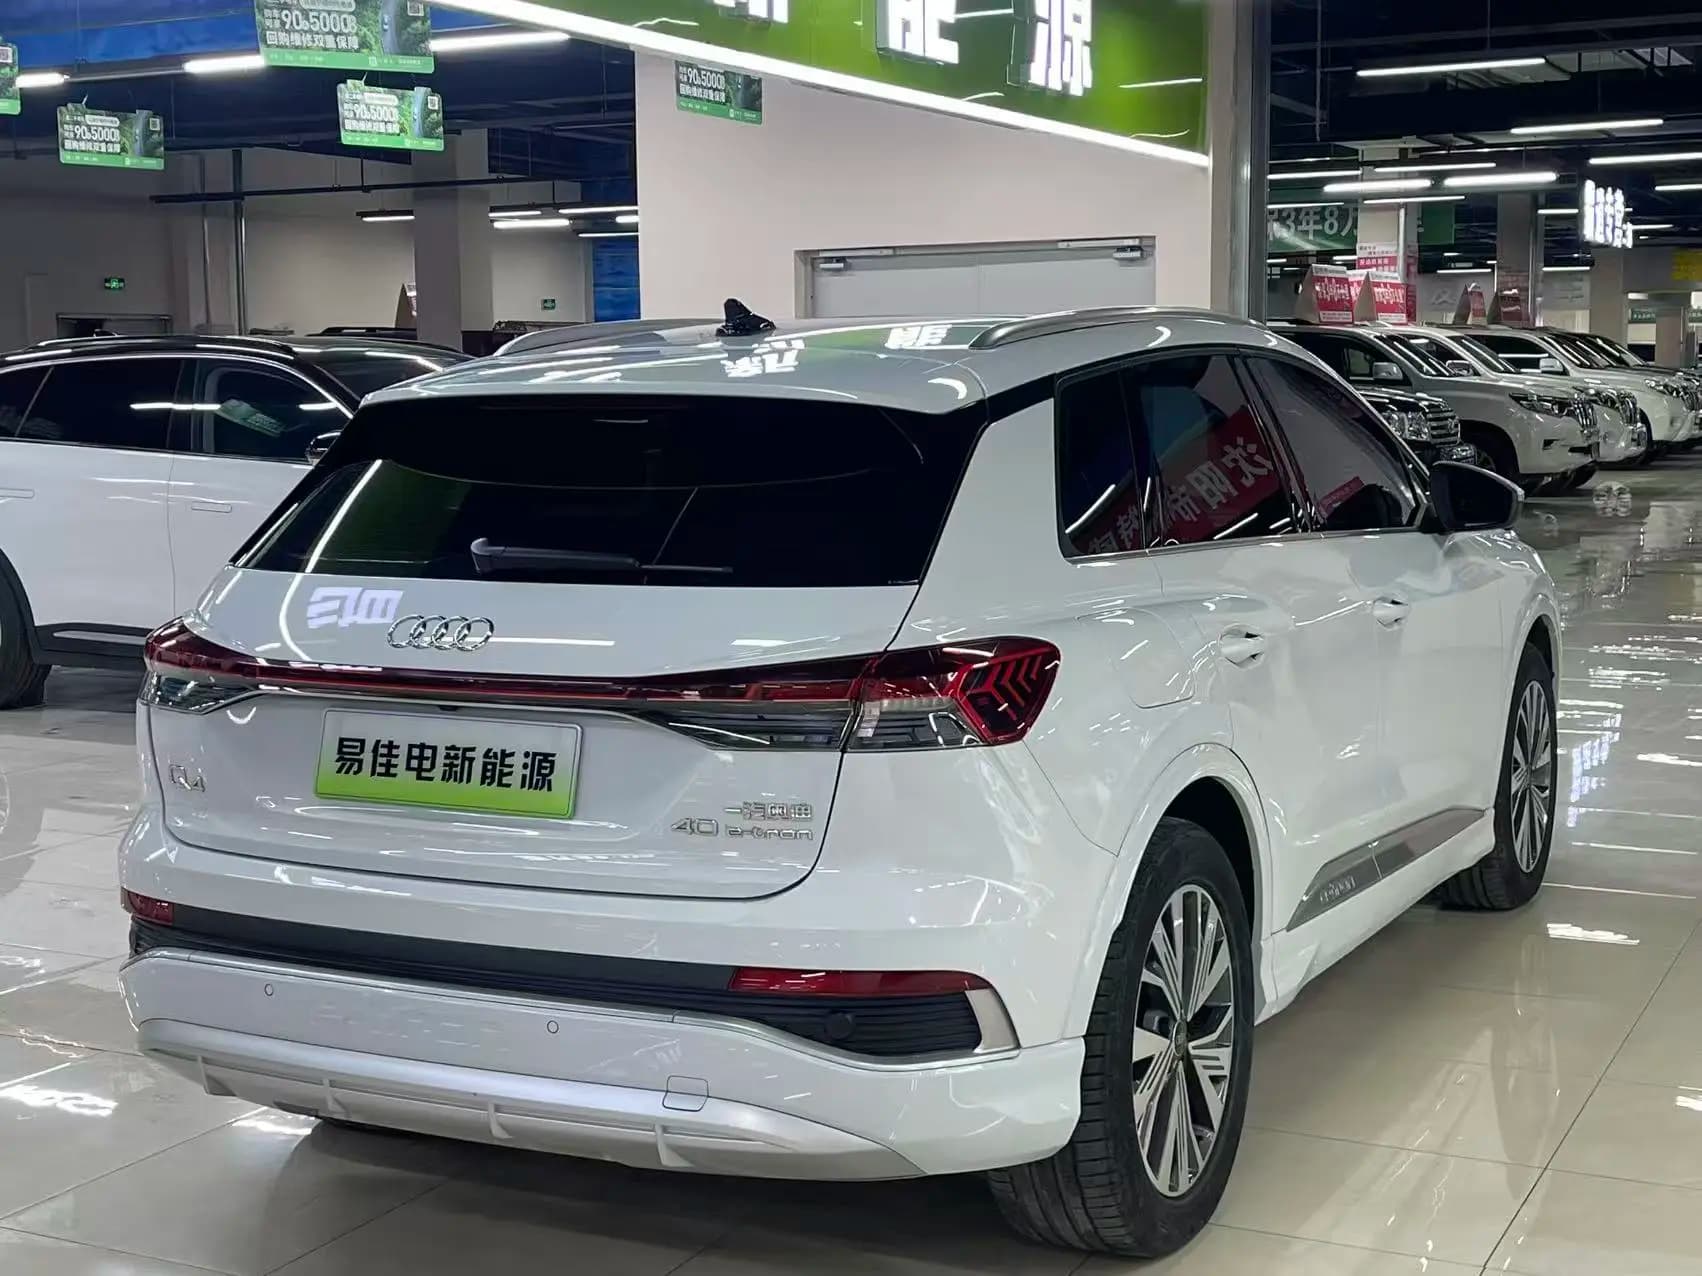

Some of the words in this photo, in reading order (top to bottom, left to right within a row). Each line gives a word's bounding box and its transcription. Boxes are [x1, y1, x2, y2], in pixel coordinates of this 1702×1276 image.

[334, 735, 557, 792] 易佳电新能源
[670, 816, 719, 837] 40
[725, 823, 814, 841] e-tron
